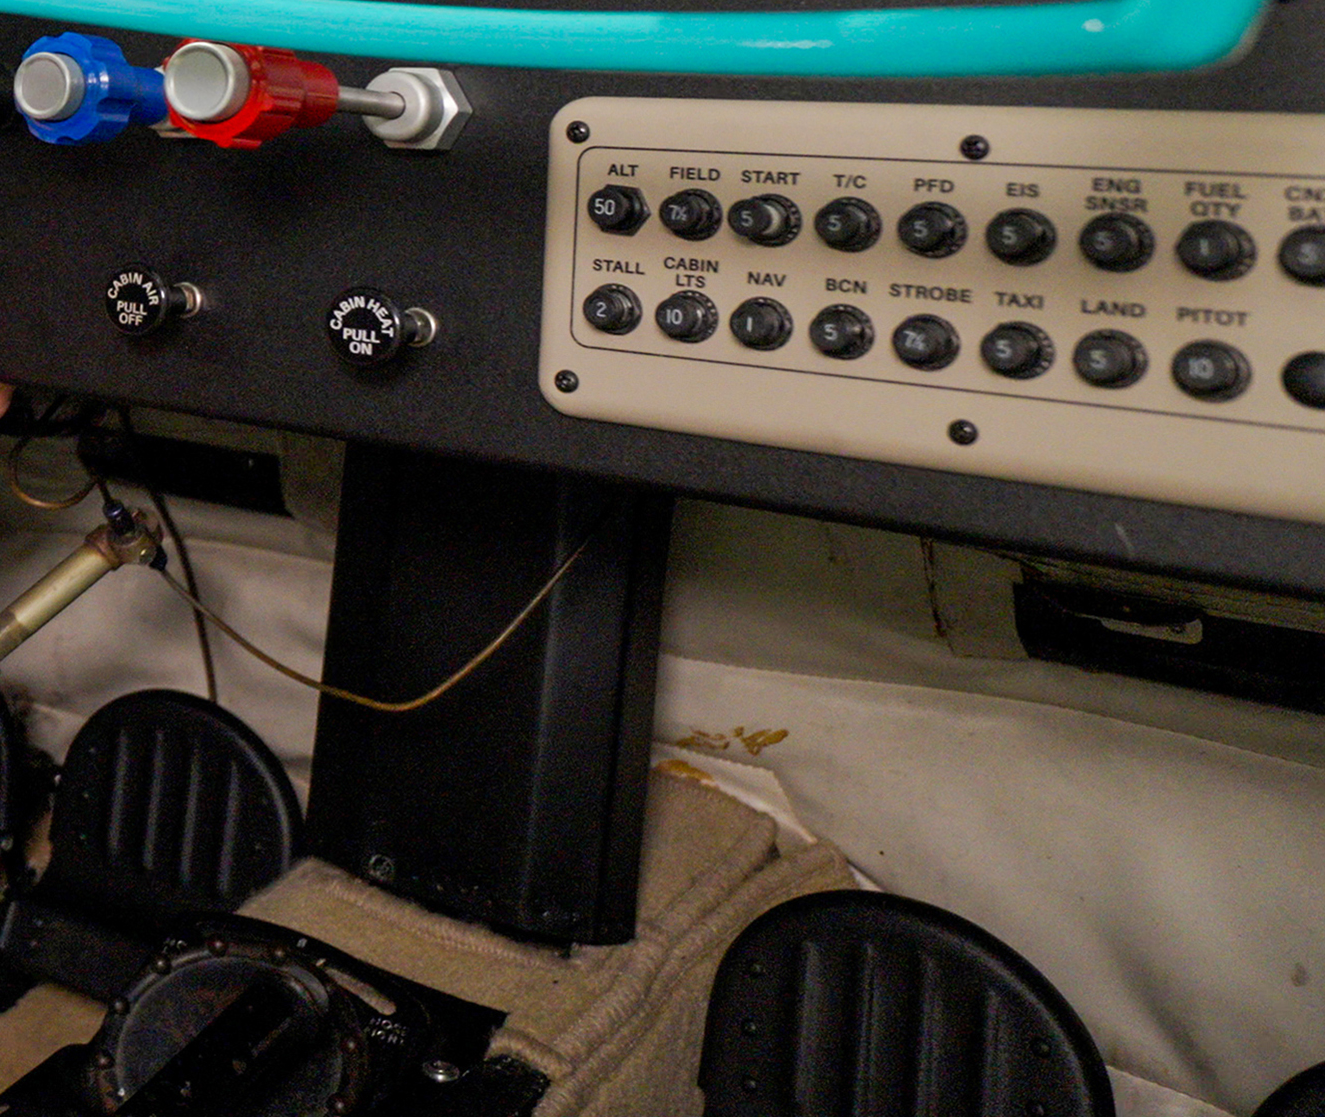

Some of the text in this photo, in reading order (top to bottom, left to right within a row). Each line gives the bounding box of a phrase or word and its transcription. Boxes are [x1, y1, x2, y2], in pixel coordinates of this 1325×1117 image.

[607, 164, 1248, 200] ALT FIELD START T/C PFD EIS ENG FUEL
[594, 198, 615, 216] 50
[1084, 195, 1243, 218] SNSR QTY
[740, 210, 753, 227] 5
[828, 214, 842, 232] 5
[913, 220, 928, 238] 5
[1003, 226, 1019, 244] 5
[107, 272, 159, 306] CABIN AIR
[675, 274, 706, 288] LTS
[592, 257, 1249, 327] STALL CABIN NAV BCN STROBE TAXI LAND PITOT
[116, 300, 148, 316] PULL
[329, 295, 394, 338] CABIN HEAT
[596, 302, 607, 317] 2
[666, 309, 683, 325] 10
[118, 312, 144, 327] OFF
[342, 327, 380, 343] PULL
[824, 323, 838, 341] 5
[349, 341, 373, 356] ON
[996, 339, 1012, 358] 5
[1089, 349, 1108, 369] 5
